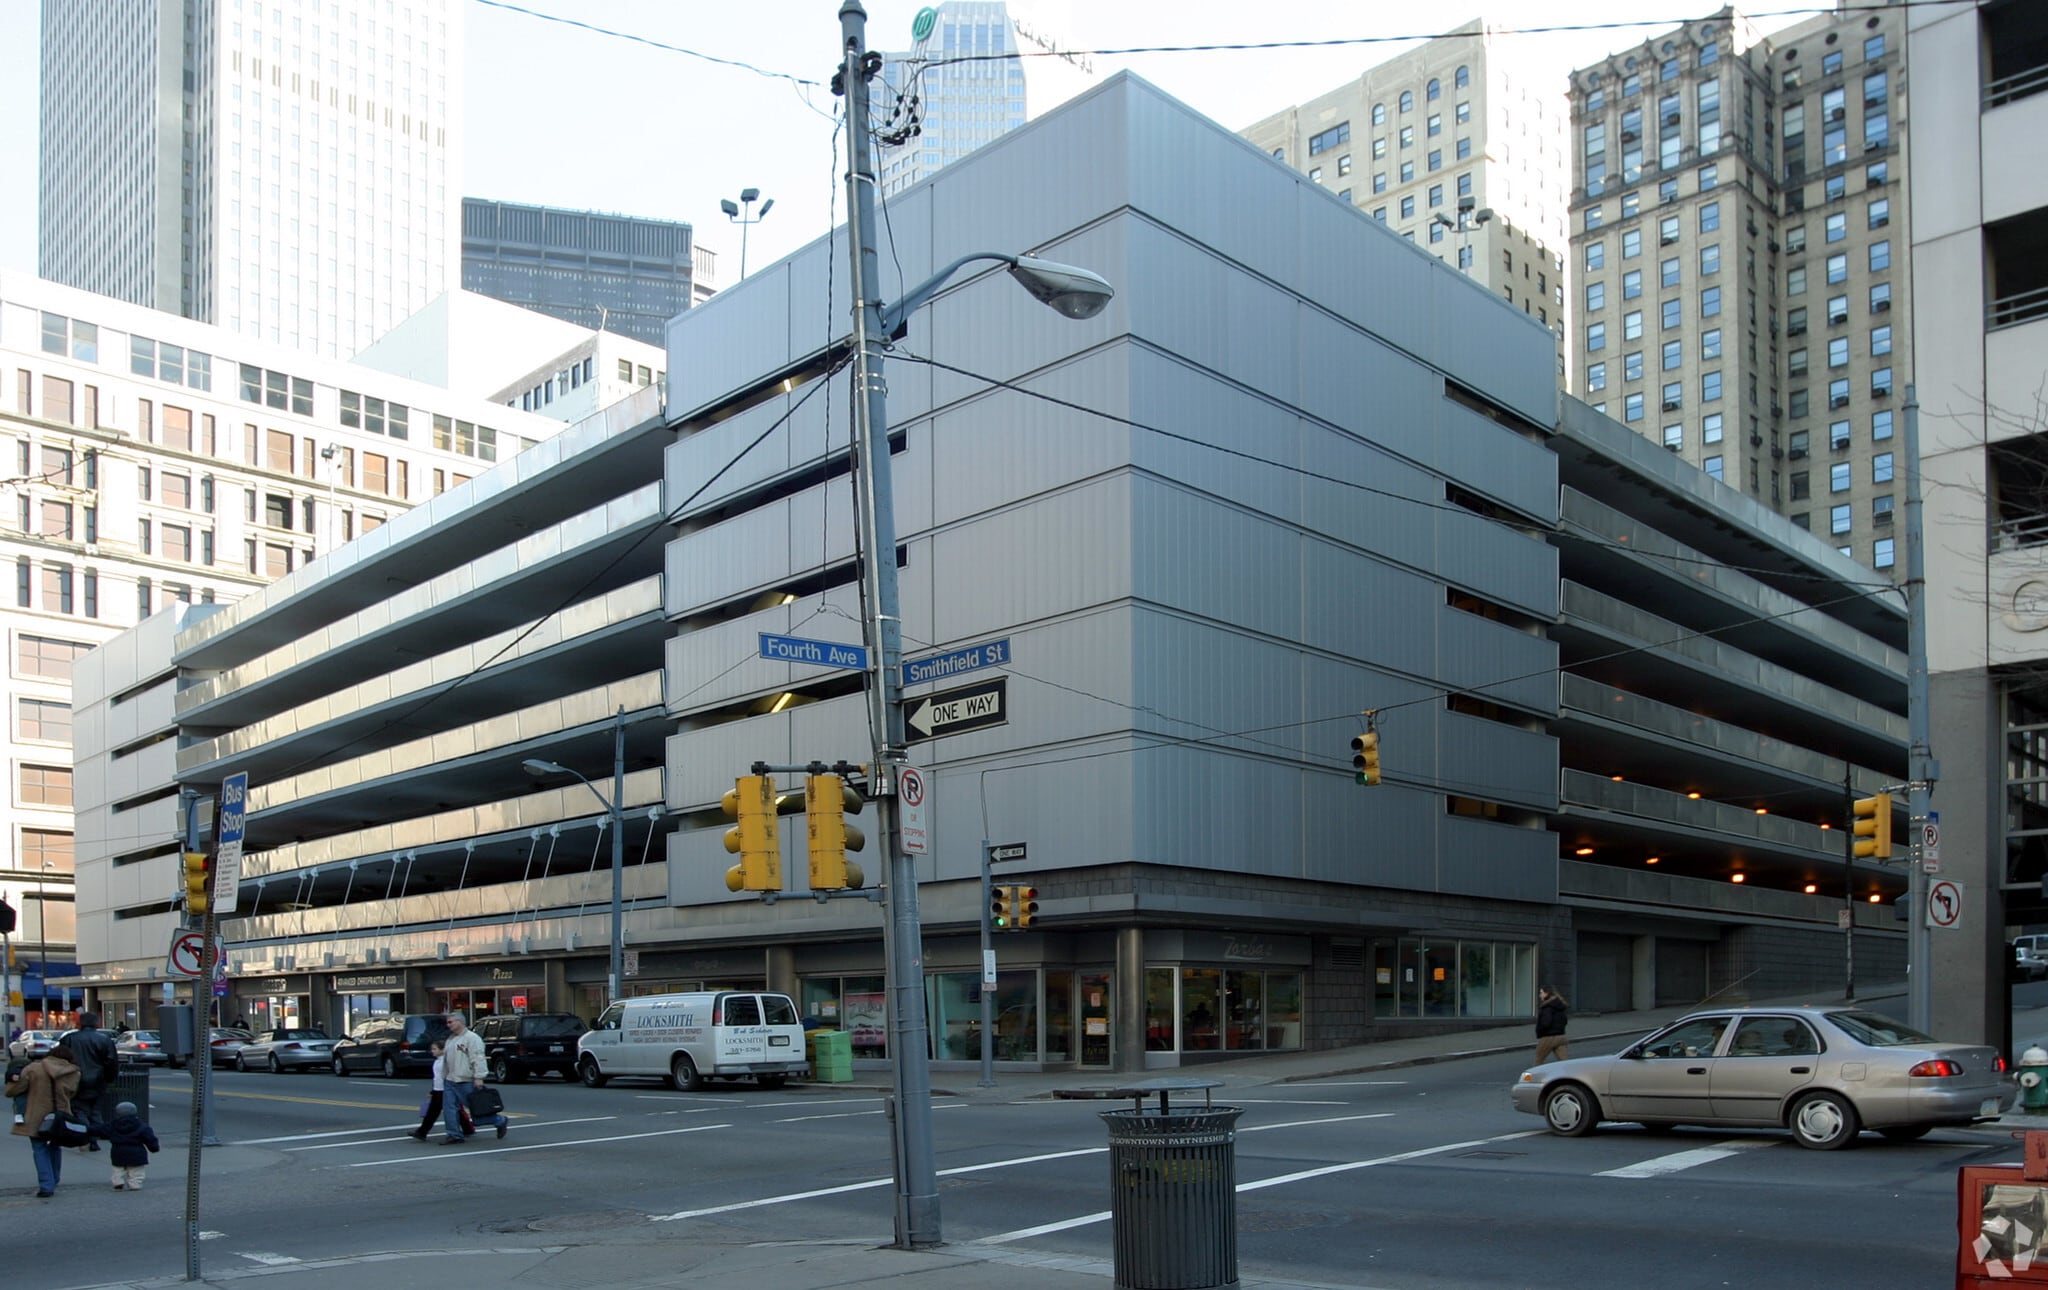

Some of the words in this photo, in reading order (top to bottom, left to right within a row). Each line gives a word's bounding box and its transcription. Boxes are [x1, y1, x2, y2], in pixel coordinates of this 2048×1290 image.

[767, 638, 822, 661] Fourth
[828, 645, 858, 665] Ave
[910, 650, 980, 682] Smithfield
[986, 644, 1003, 662] St
[932, 703, 960, 723] ONE
[966, 694, 995, 715] WAY
[224, 783, 243, 804] Bus
[222, 812, 243, 836] Stop
[999, 848, 1010, 857] ONE
[1011, 846, 1023, 856] WAY
[492, 968, 513, 980] Pizza
[637, 1014, 693, 1028] LOCKSMITH
[1116, 1137, 1165, 1146] DOWNTOWN
[1168, 1134, 1225, 1145] PARTNERSHIP
